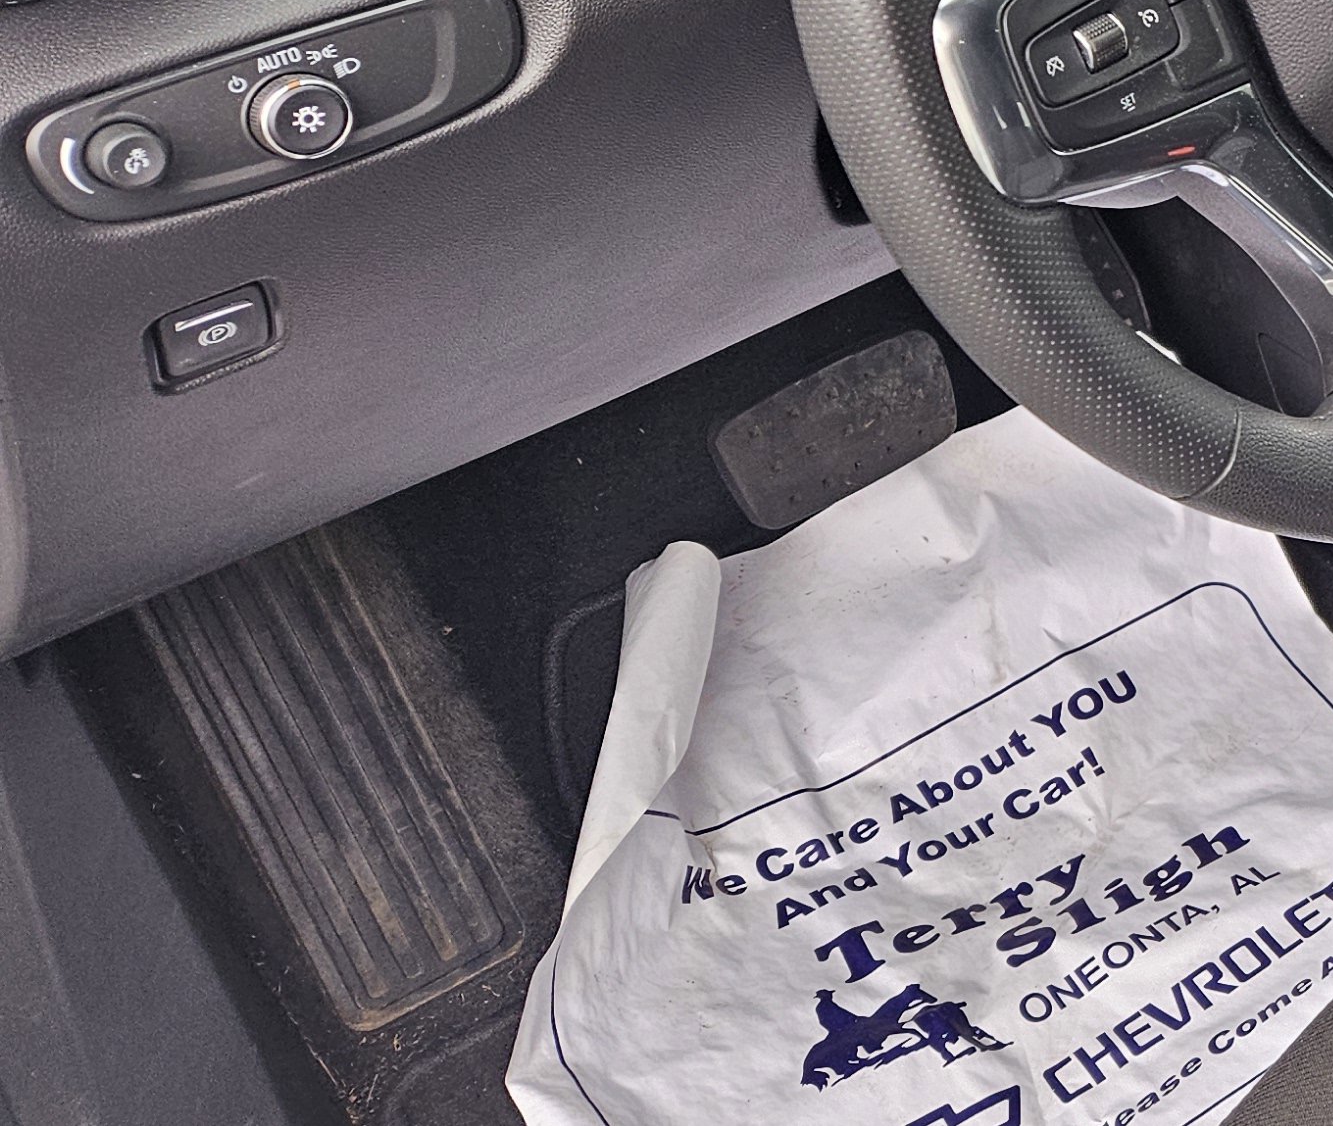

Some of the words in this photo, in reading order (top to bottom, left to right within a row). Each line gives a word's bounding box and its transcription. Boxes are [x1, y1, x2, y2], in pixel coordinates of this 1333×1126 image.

[256, 46, 303, 73] AUTO
[1120, 92, 1136, 109] SET
[680, 865, 747, 904] We
[755, 816, 881, 883] Care
[888, 729, 1036, 824] About
[1030, 670, 1138, 738] YOU
[775, 867, 878, 930] And
[877, 811, 996, 879] Your
[1002, 746, 1106, 821] Car!
[814, 853, 1086, 984] Terry
[995, 825, 1251, 968] Sligh
[1018, 901, 1221, 1023] ONEONTA,
[1230, 865, 1281, 897] AL
[1102, 1056, 1203, 1126] ease
[1207, 977, 1314, 1054] Come
